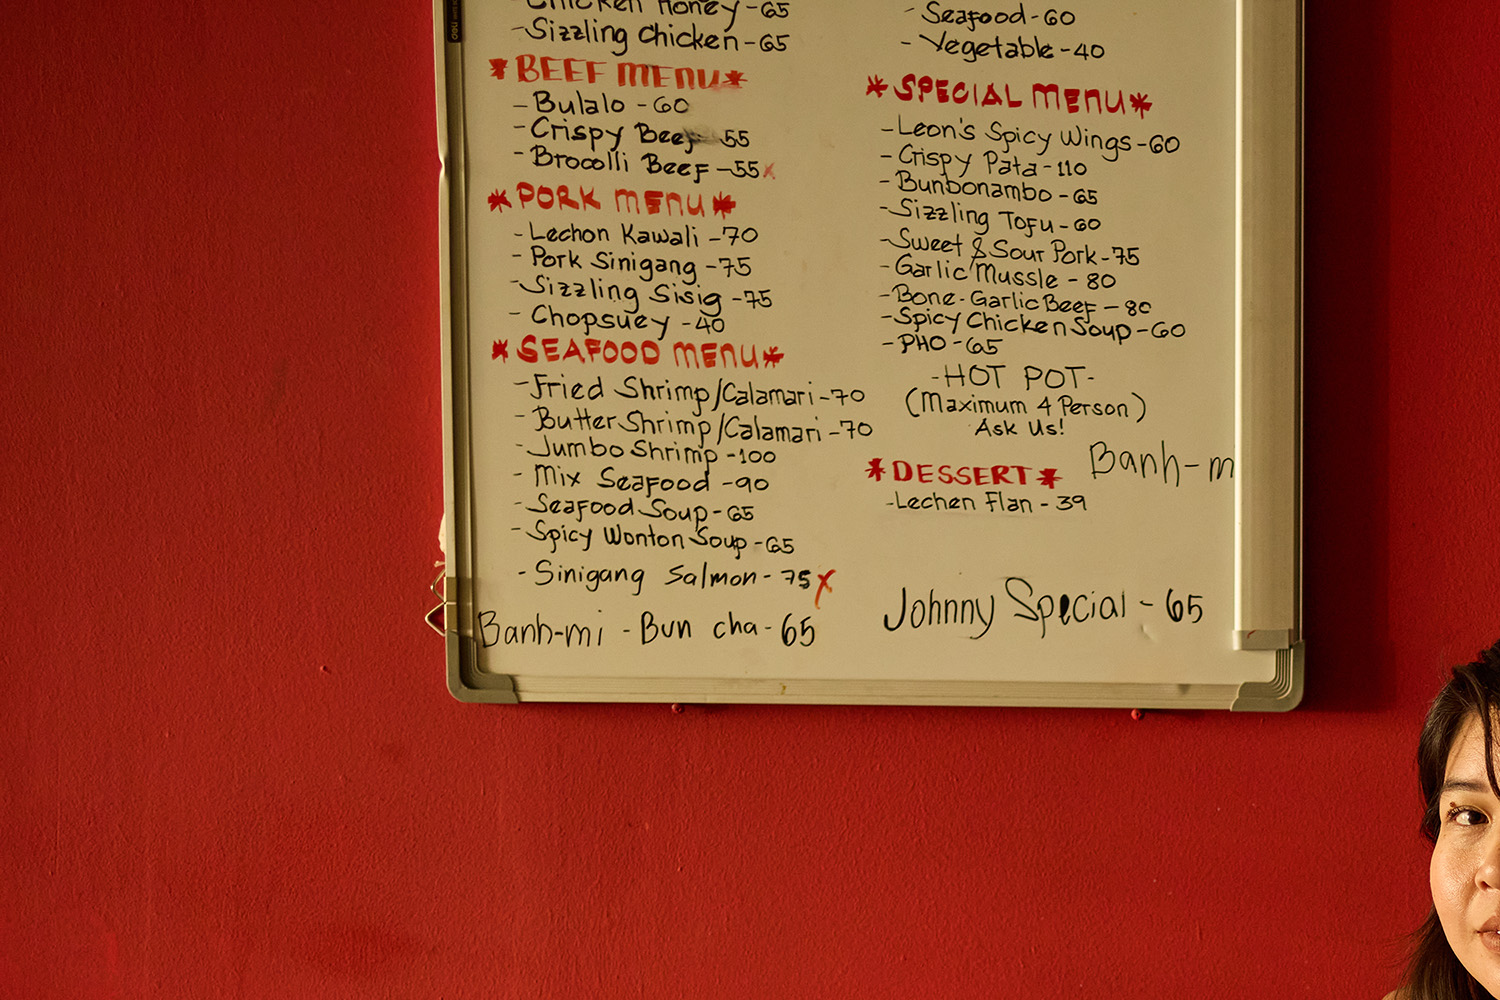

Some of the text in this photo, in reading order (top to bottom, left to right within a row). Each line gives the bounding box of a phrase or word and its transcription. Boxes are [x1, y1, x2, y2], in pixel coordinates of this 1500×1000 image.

[525, 17, 628, 56] Sizzling
[638, 23, 738, 51] Chicken
[919, 31, 1054, 63] Vegetable
[515, 54, 606, 83] BEEF
[533, 90, 625, 115] Bulalo
[894, 74, 1022, 108] SPECIAL
[531, 116, 624, 152] Crispy
[899, 115, 975, 140] Leon's
[985, 121, 1052, 156] Spicy
[1061, 125, 1131, 162] Wings
[899, 143, 972, 178] Crispy
[983, 150, 1037, 177] Pata
[516, 182, 601, 210] PORK
[888, 198, 989, 235] Sizzling
[529, 222, 609, 243] Lechon
[621, 223, 698, 247] Kawali
[885, 227, 963, 257] Sweet
[969, 237, 987, 271] &
[989, 239, 1045, 262] Sour
[1051, 239, 1097, 265] Pork
[531, 245, 582, 269] Pork
[590, 251, 697, 287] Sinigang
[895, 253, 968, 280] Garlic
[976, 263, 1058, 289] Mussle
[519, 274, 639, 314] Sizzling
[649, 283, 722, 317] Sisig
[531, 304, 670, 341] Chopsuey
[894, 306, 961, 334] Spicy
[967, 312, 1066, 336] Chicken
[1070, 317, 1131, 345] Soup
[517, 334, 660, 365] SEAFOOD
[898, 333, 946, 354] PHO
[530, 373, 604, 400] Fried
[532, 405, 616, 431] Butter
[975, 418, 1064, 437] Ask Us!
[527, 435, 624, 458] Jumbo
[630, 439, 718, 475] Shrimp
[535, 464, 580, 487] Mix
[892, 461, 1032, 486] DESSERT
[638, 498, 708, 535] Soup
[985, 491, 1032, 513] Flan
[526, 519, 592, 553] Spicy
[604, 524, 684, 549] Wonton
[688, 526, 747, 560] Soup
[535, 559, 644, 596] Sinigang
[664, 562, 756, 589] Salmon
[884, 587, 994, 640] Johnny
[1005, 577, 1125, 639] Special
[641, 611, 691, 645] Bun
[713, 611, 757, 639] cha
